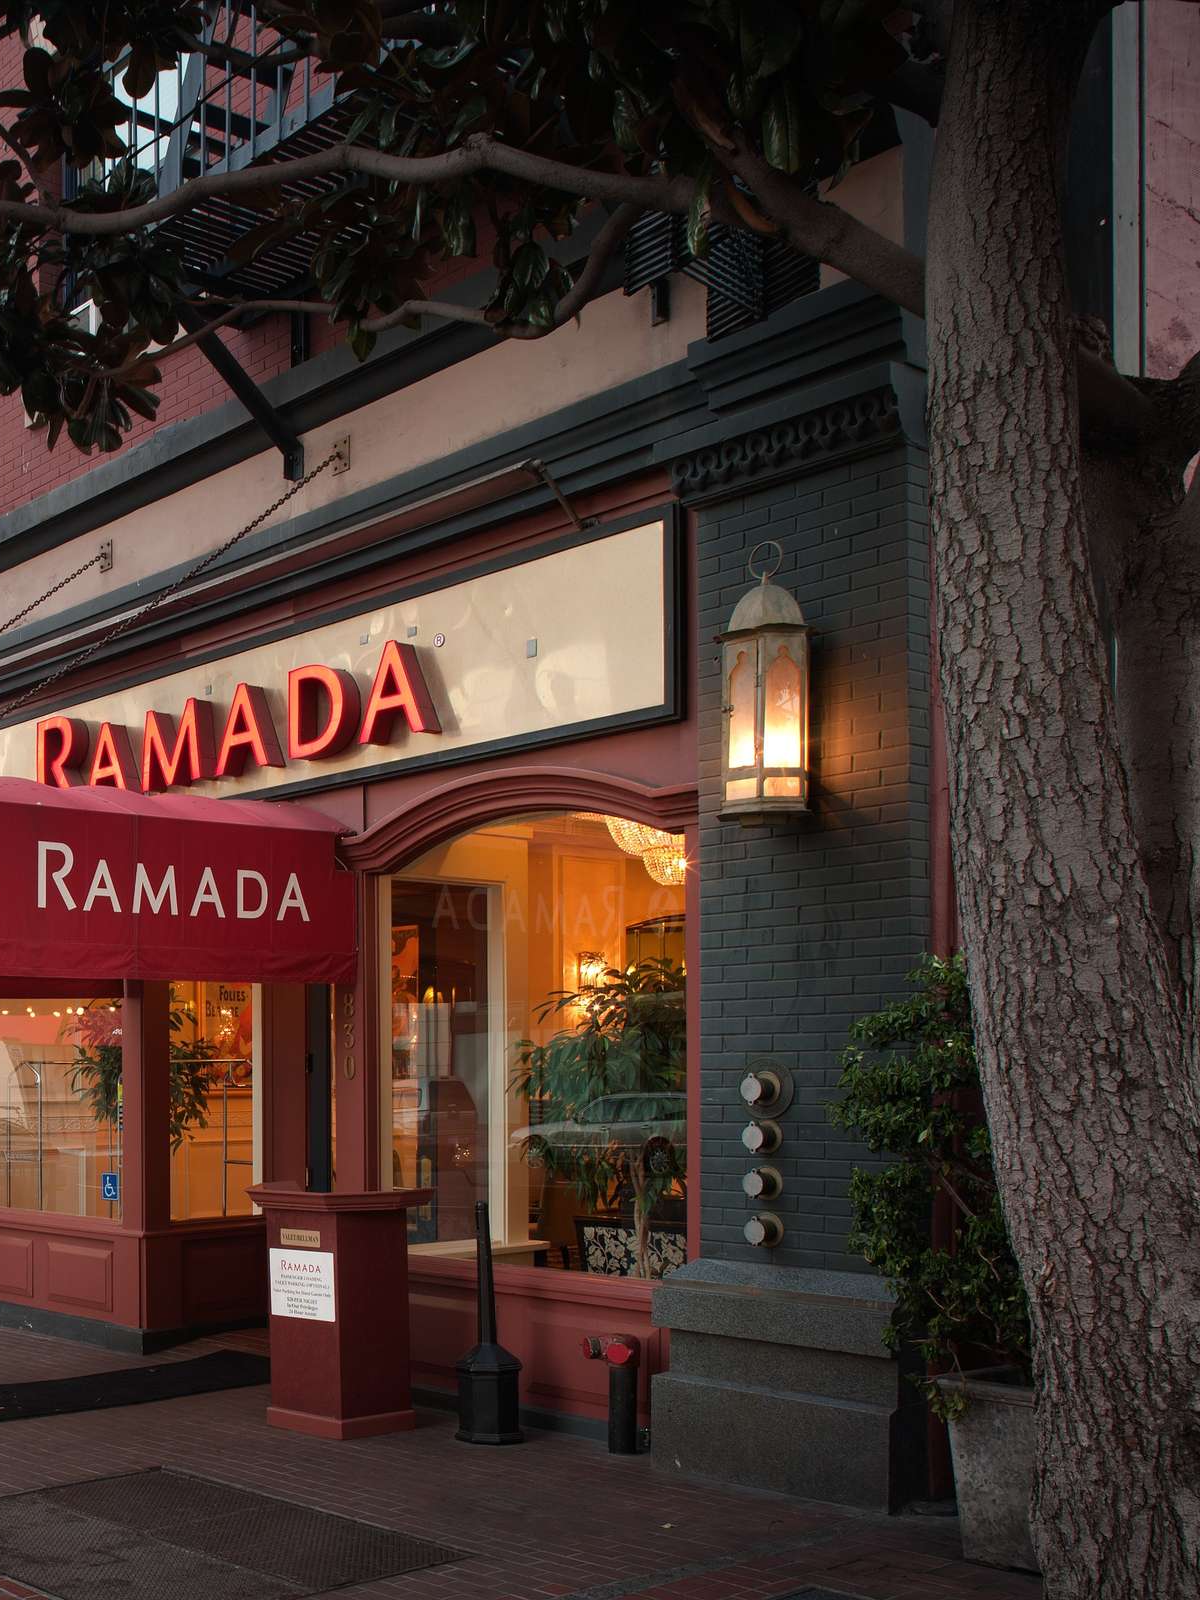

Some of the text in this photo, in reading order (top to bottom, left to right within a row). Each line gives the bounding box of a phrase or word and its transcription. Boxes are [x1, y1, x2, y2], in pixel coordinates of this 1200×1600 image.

[36, 639, 442, 793] RAMADA
[37, 840, 311, 922] RAMADA
[280, 1259, 321, 1273] RAMADA
